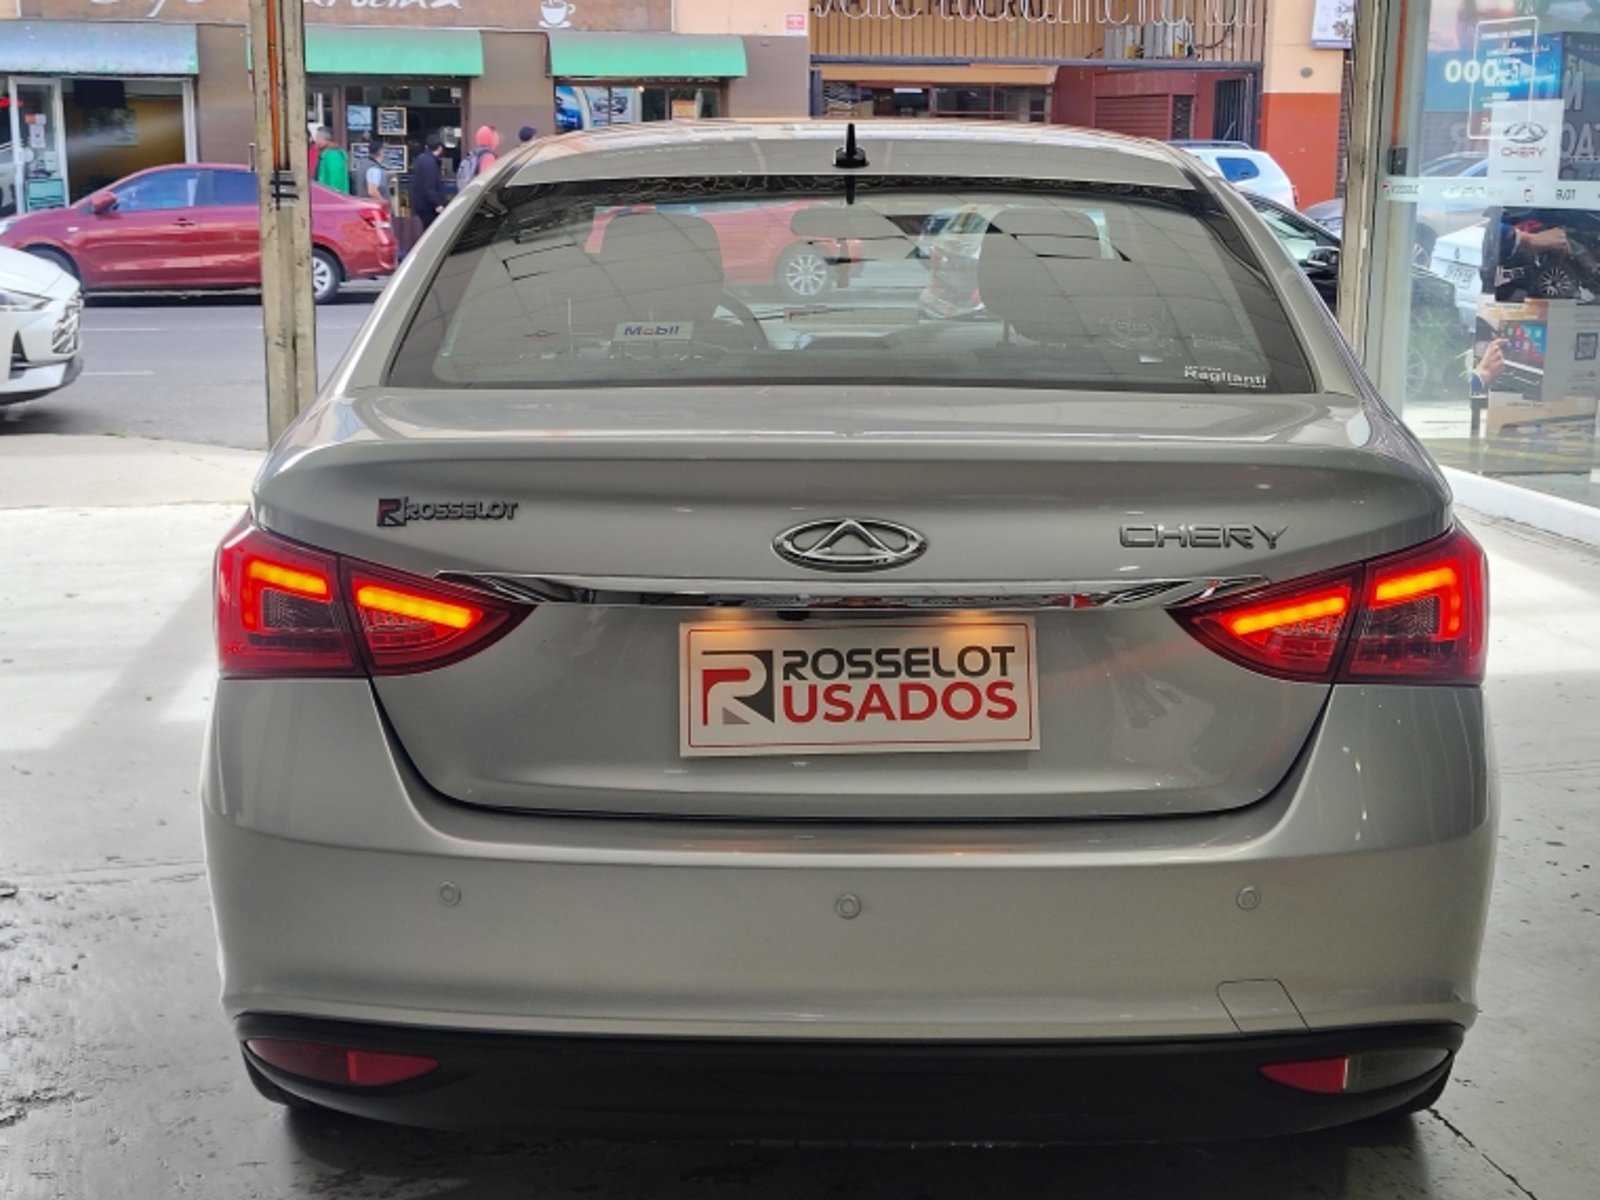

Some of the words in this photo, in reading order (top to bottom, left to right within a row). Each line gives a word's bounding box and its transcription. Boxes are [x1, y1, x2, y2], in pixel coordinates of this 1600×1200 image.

[623, 326, 680, 336] Mobil
[405, 501, 518, 520] ROSSELOT
[1119, 523, 1289, 550] CHERY
[782, 646, 1015, 680] ROSSELOT
[782, 681, 1018, 723] USADOS
